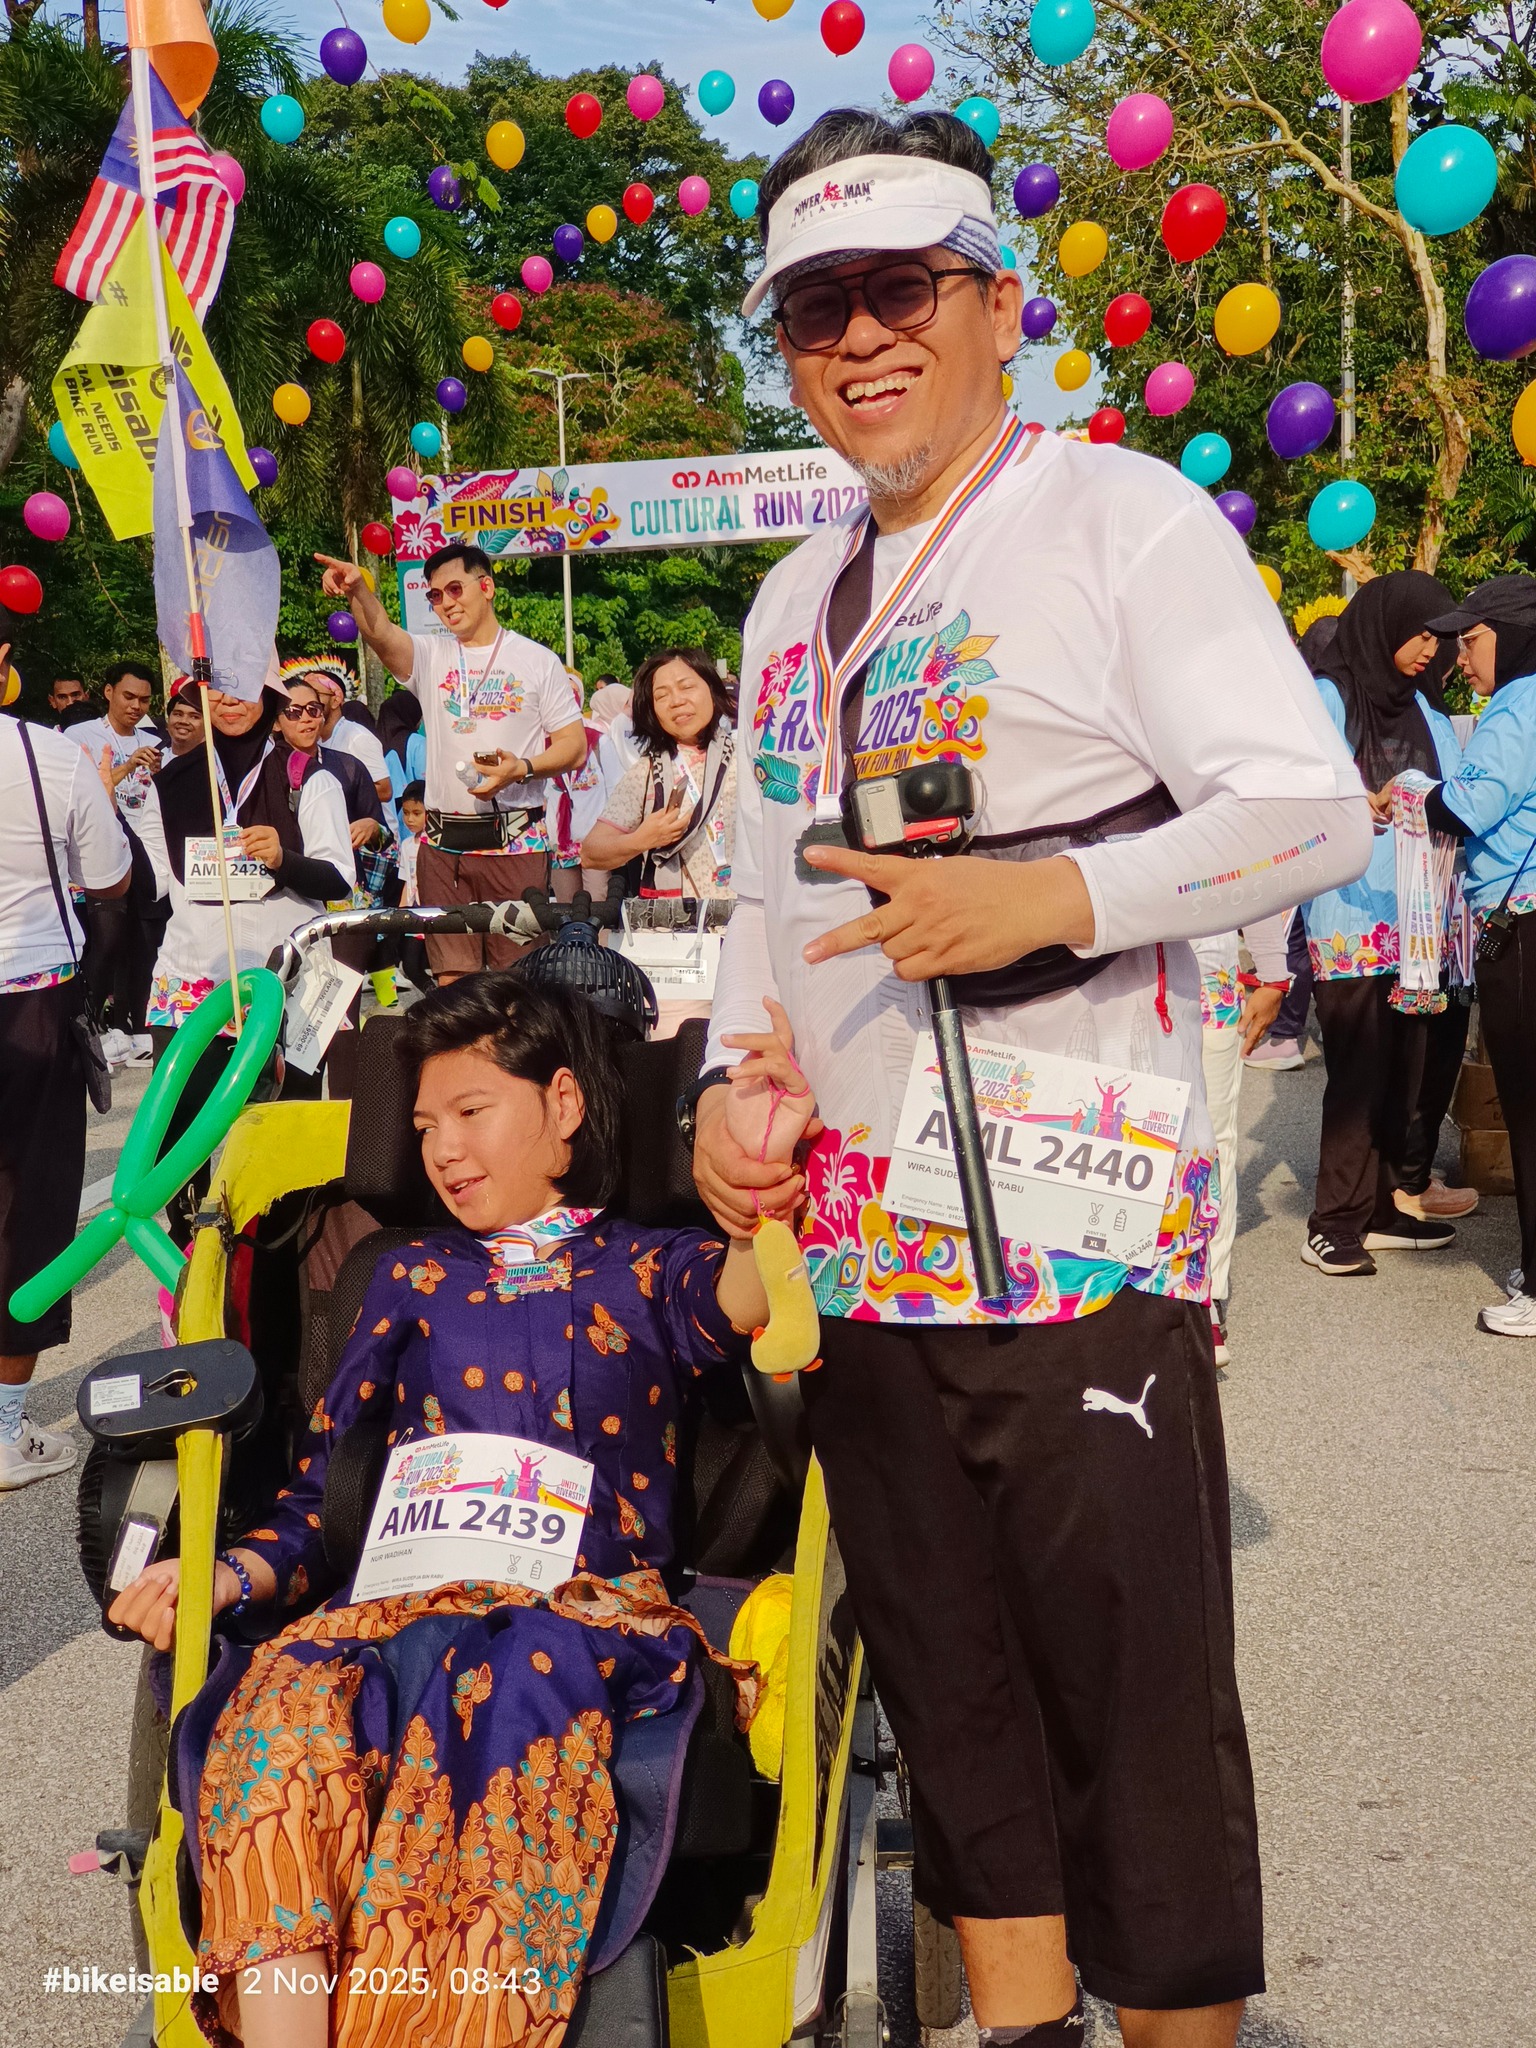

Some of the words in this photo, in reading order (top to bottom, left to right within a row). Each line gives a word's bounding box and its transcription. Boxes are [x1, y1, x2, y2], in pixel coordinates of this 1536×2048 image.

[793, 192, 821, 221] POWER
[64, 377, 88, 417] BIKE
[81, 423, 105, 455] RUN
[91, 402, 122, 451] NEEDS
[705, 461, 827, 487] AmMetLife
[450, 500, 546, 528] FINISH
[630, 494, 746, 537] CULTURAL
[753, 489, 804, 528] RUN
[479, 691, 507, 705] 2025
[856, 687, 928, 752] 2025
[230, 863, 268, 876] 2428
[972, 1046, 1016, 1061] AmMetLife
[977, 1079, 1012, 1100] 2025
[1148, 1109, 1170, 1123] UNITY
[1170, 1113, 1179, 1125] IN
[1142, 1120, 1178, 1136] DIVERSITY
[1033, 1135, 1154, 1192] 2440
[907, 1161, 932, 1174] WIRA
[997, 1180, 1025, 1194] RABU
[1088, 1239, 1099, 1248] XL
[1124, 1249, 1139, 1262] AML
[1137, 1240, 1154, 1254] 2440
[421, 1441, 450, 1452] AmMetLife
[409, 1451, 446, 1471] CULTURAL
[405, 1469, 423, 1486] RUN
[422, 1465, 445, 1482] 2025
[555, 1486, 586, 1502] DIVERSITY
[560, 1479, 579, 1492] UNITY
[579, 1485, 587, 1494] IN
[378, 1498, 450, 1541] AML
[459, 1499, 566, 1545] 2439
[370, 1554, 384, 1563] NUR
